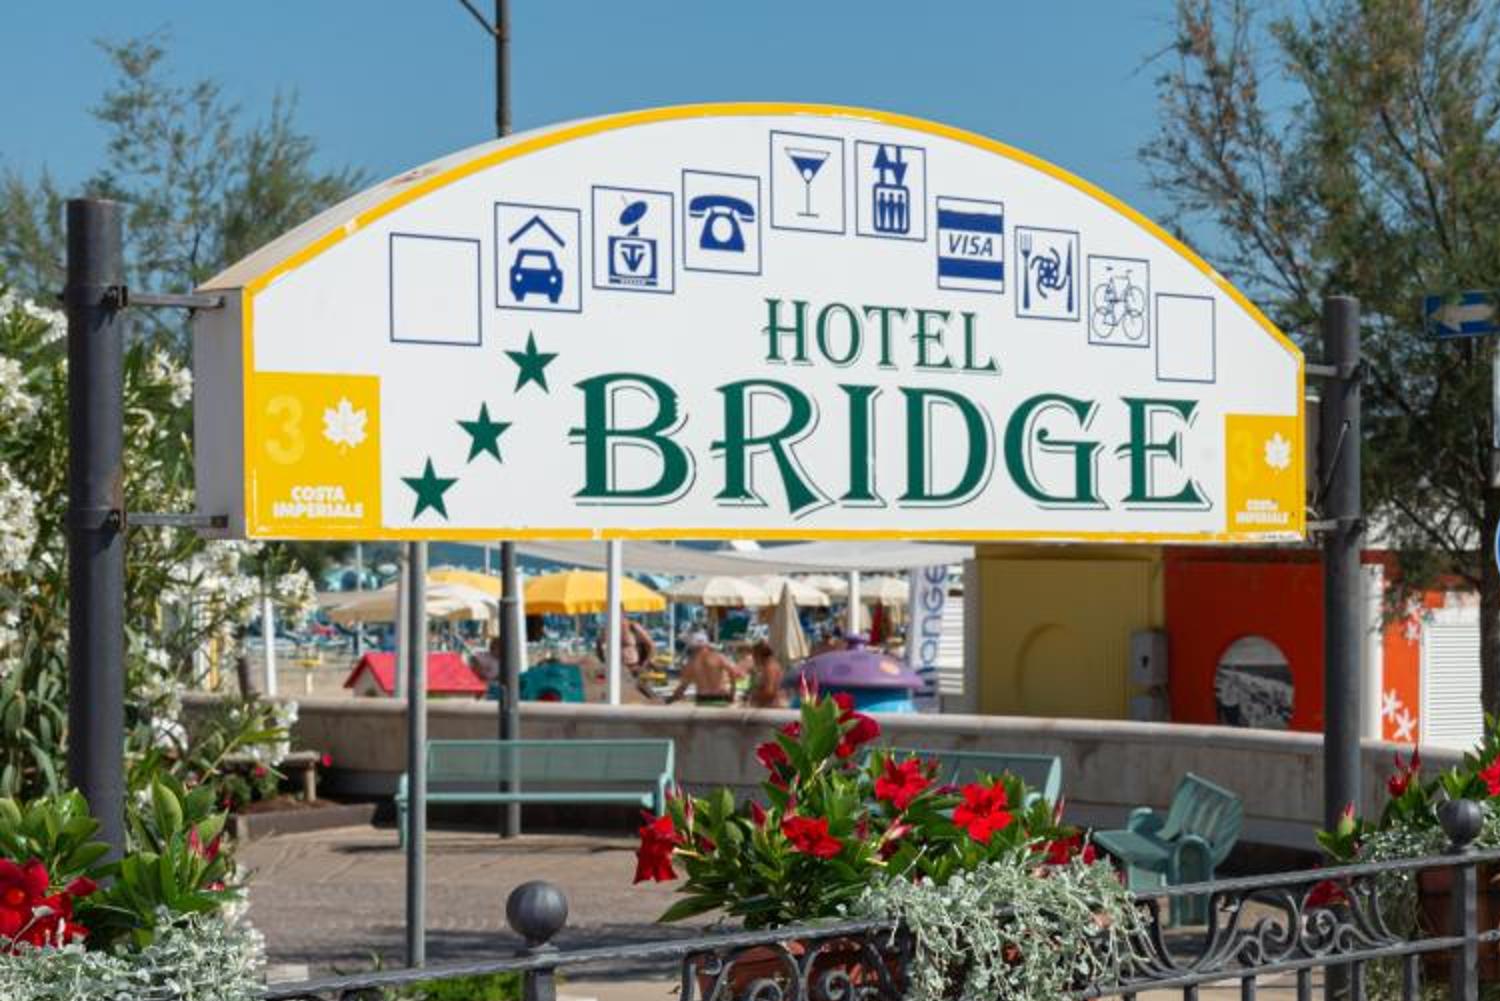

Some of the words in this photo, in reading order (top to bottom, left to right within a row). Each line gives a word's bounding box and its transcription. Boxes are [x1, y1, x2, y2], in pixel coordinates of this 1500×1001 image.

[949, 232, 993, 257] VISA
[764, 298, 1000, 375] HOTEL
[264, 394, 304, 465] 3
[568, 372, 1214, 520] BRIDGE
[272, 501, 363, 519] IMPERIALE
[291, 485, 346, 502] COSTA
